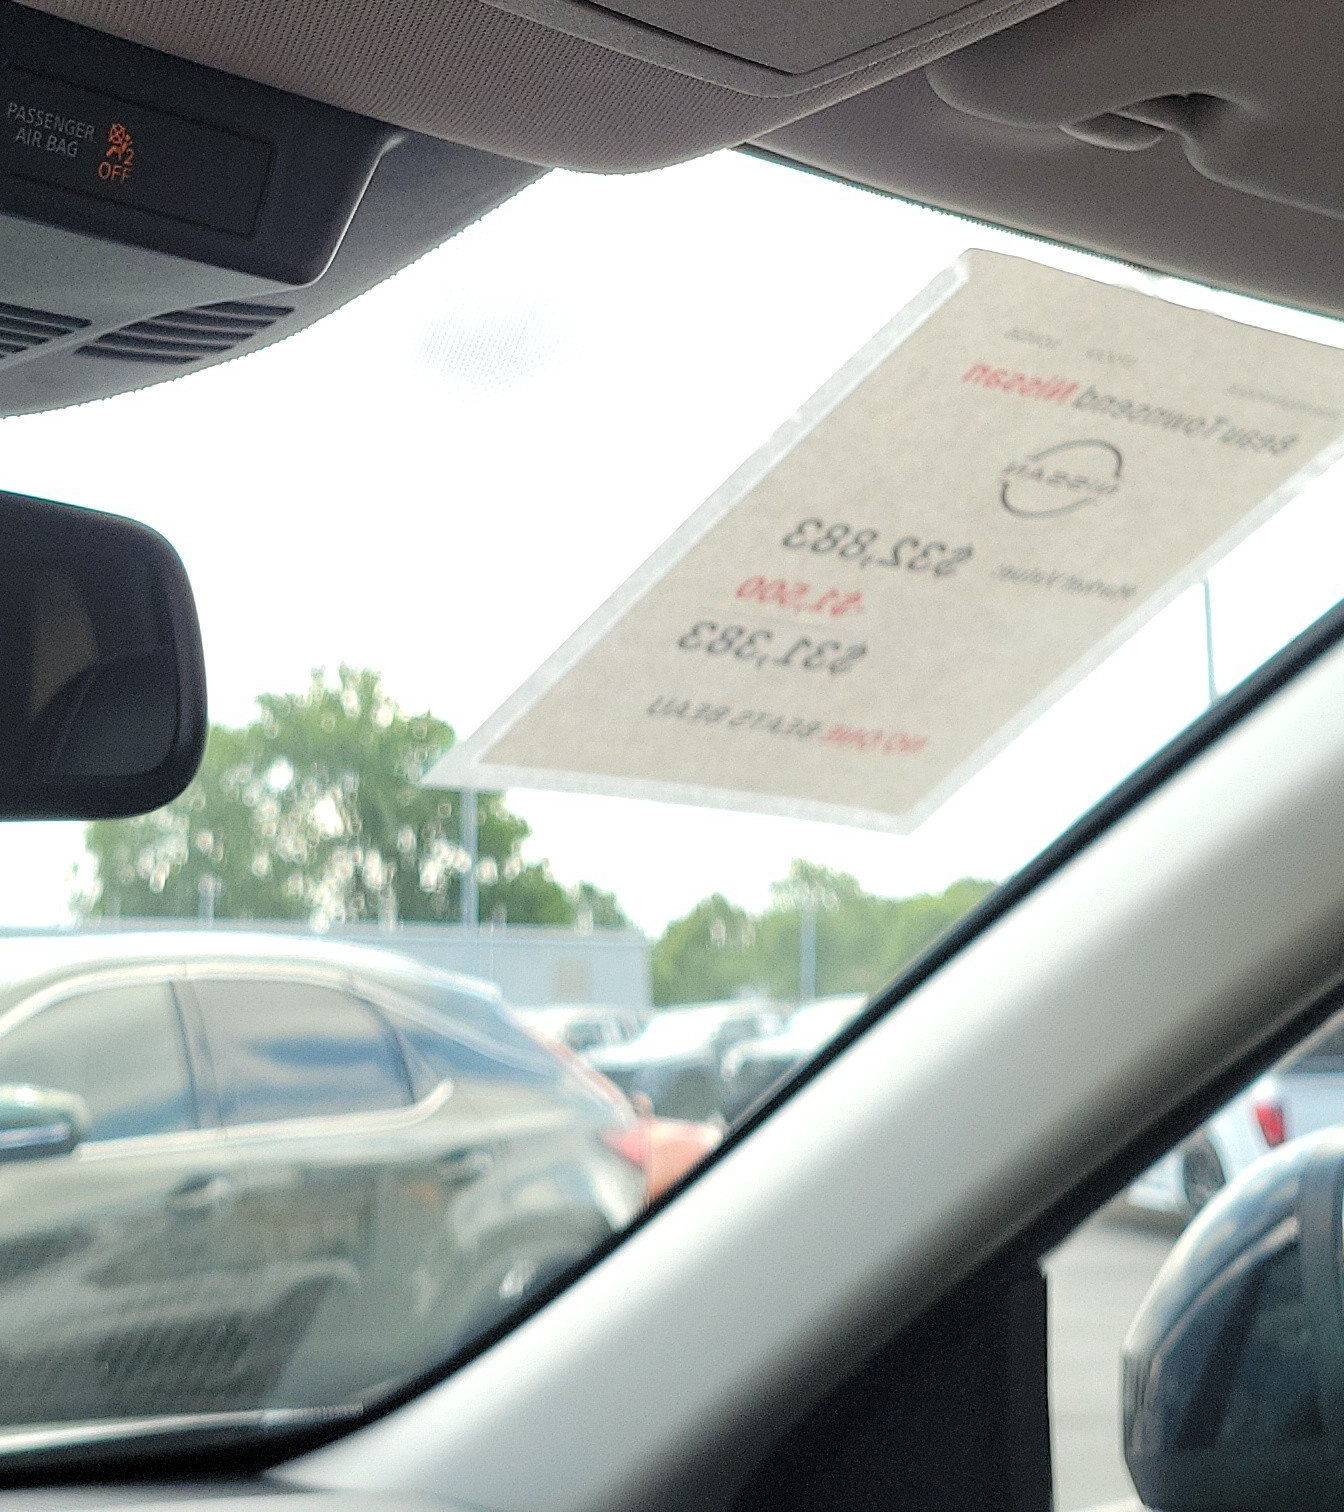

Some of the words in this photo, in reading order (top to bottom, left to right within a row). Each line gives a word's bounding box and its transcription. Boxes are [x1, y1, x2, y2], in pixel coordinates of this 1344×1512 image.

[6, 101, 96, 141] PASSENGER
[15, 126, 43, 149] AIR
[47, 134, 79, 158] BAG
[97, 161, 133, 184] OFF
